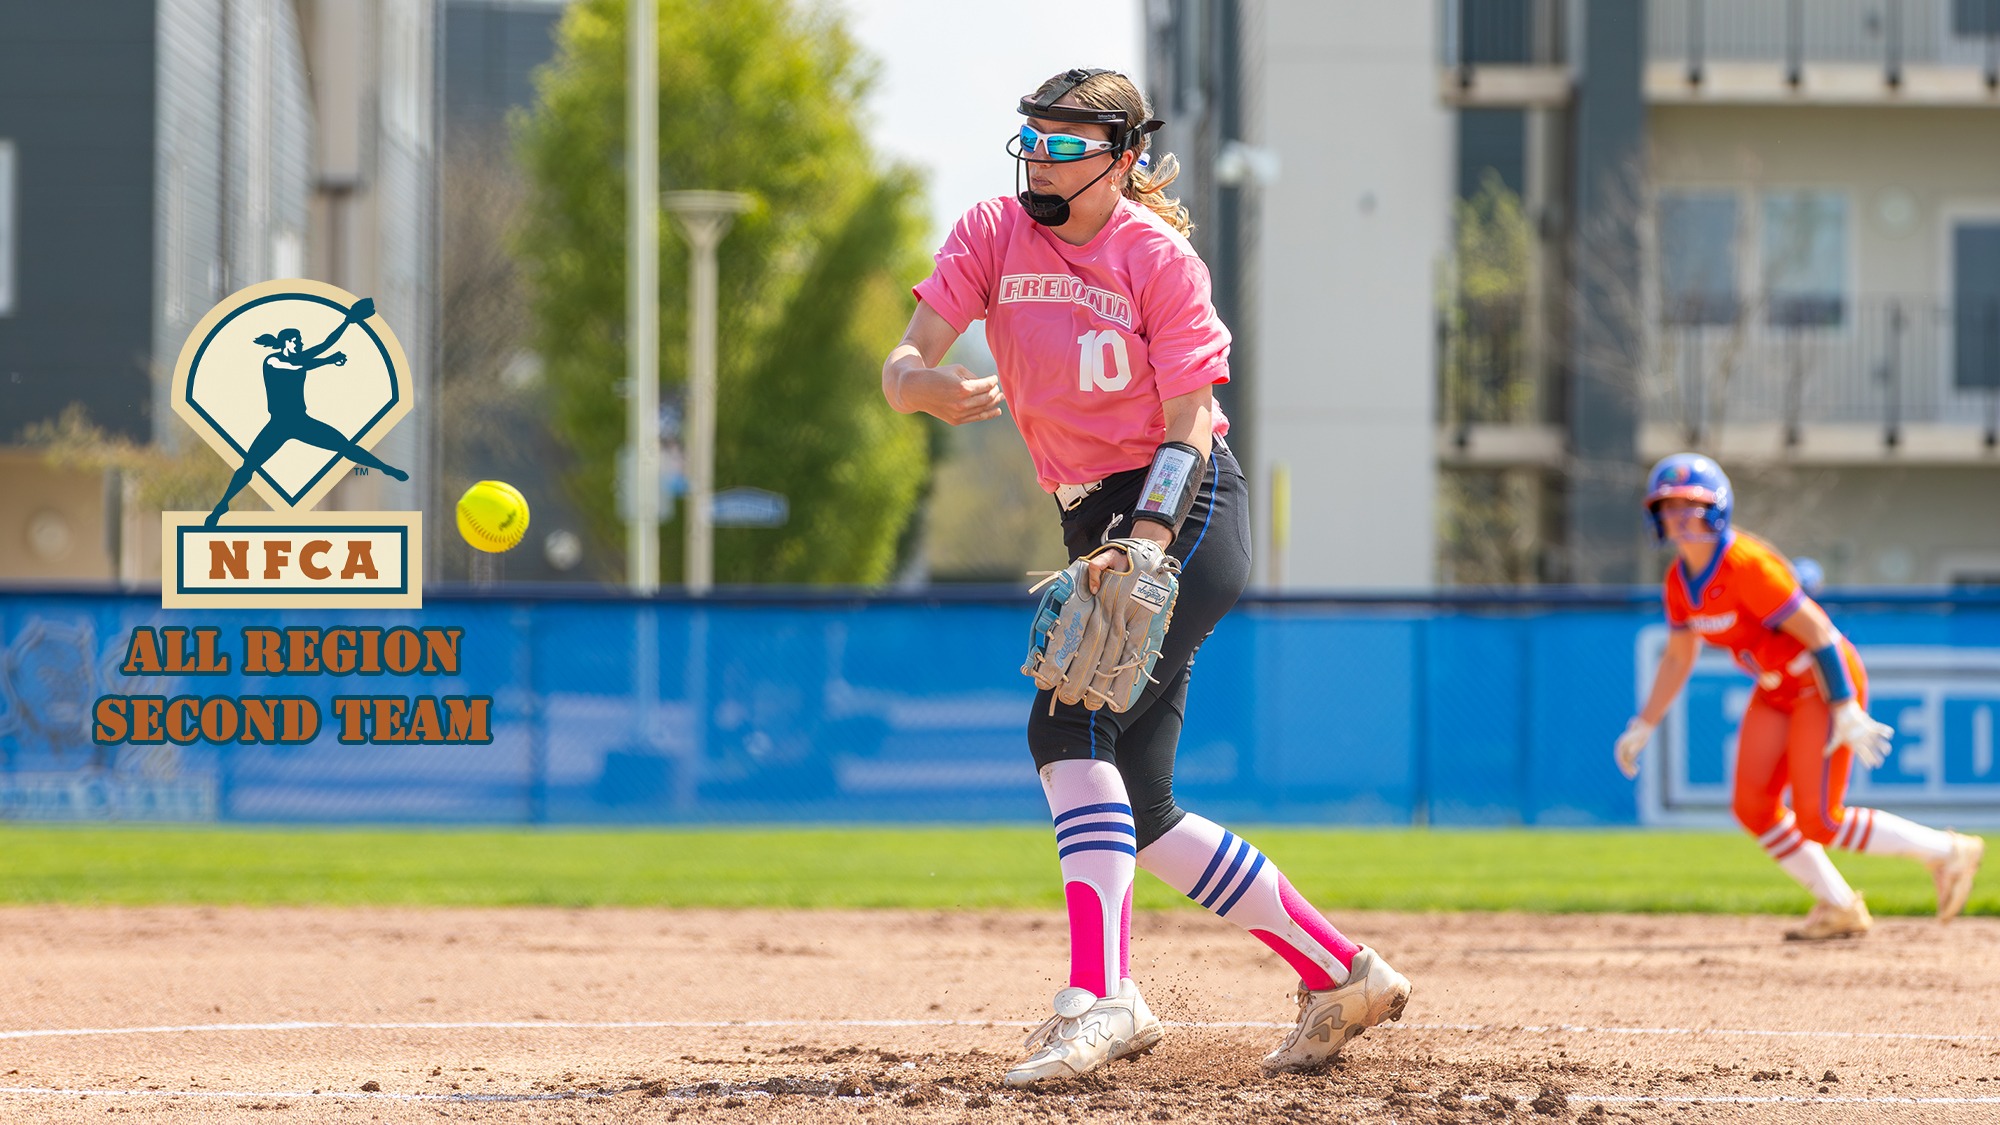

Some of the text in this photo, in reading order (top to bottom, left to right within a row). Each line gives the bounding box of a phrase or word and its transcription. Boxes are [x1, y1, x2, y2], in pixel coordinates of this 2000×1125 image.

[1000, 275, 1132, 328] FREDONIA
[1077, 329, 1132, 392] 10
[1054, 611, 1083, 668] Rawlings
